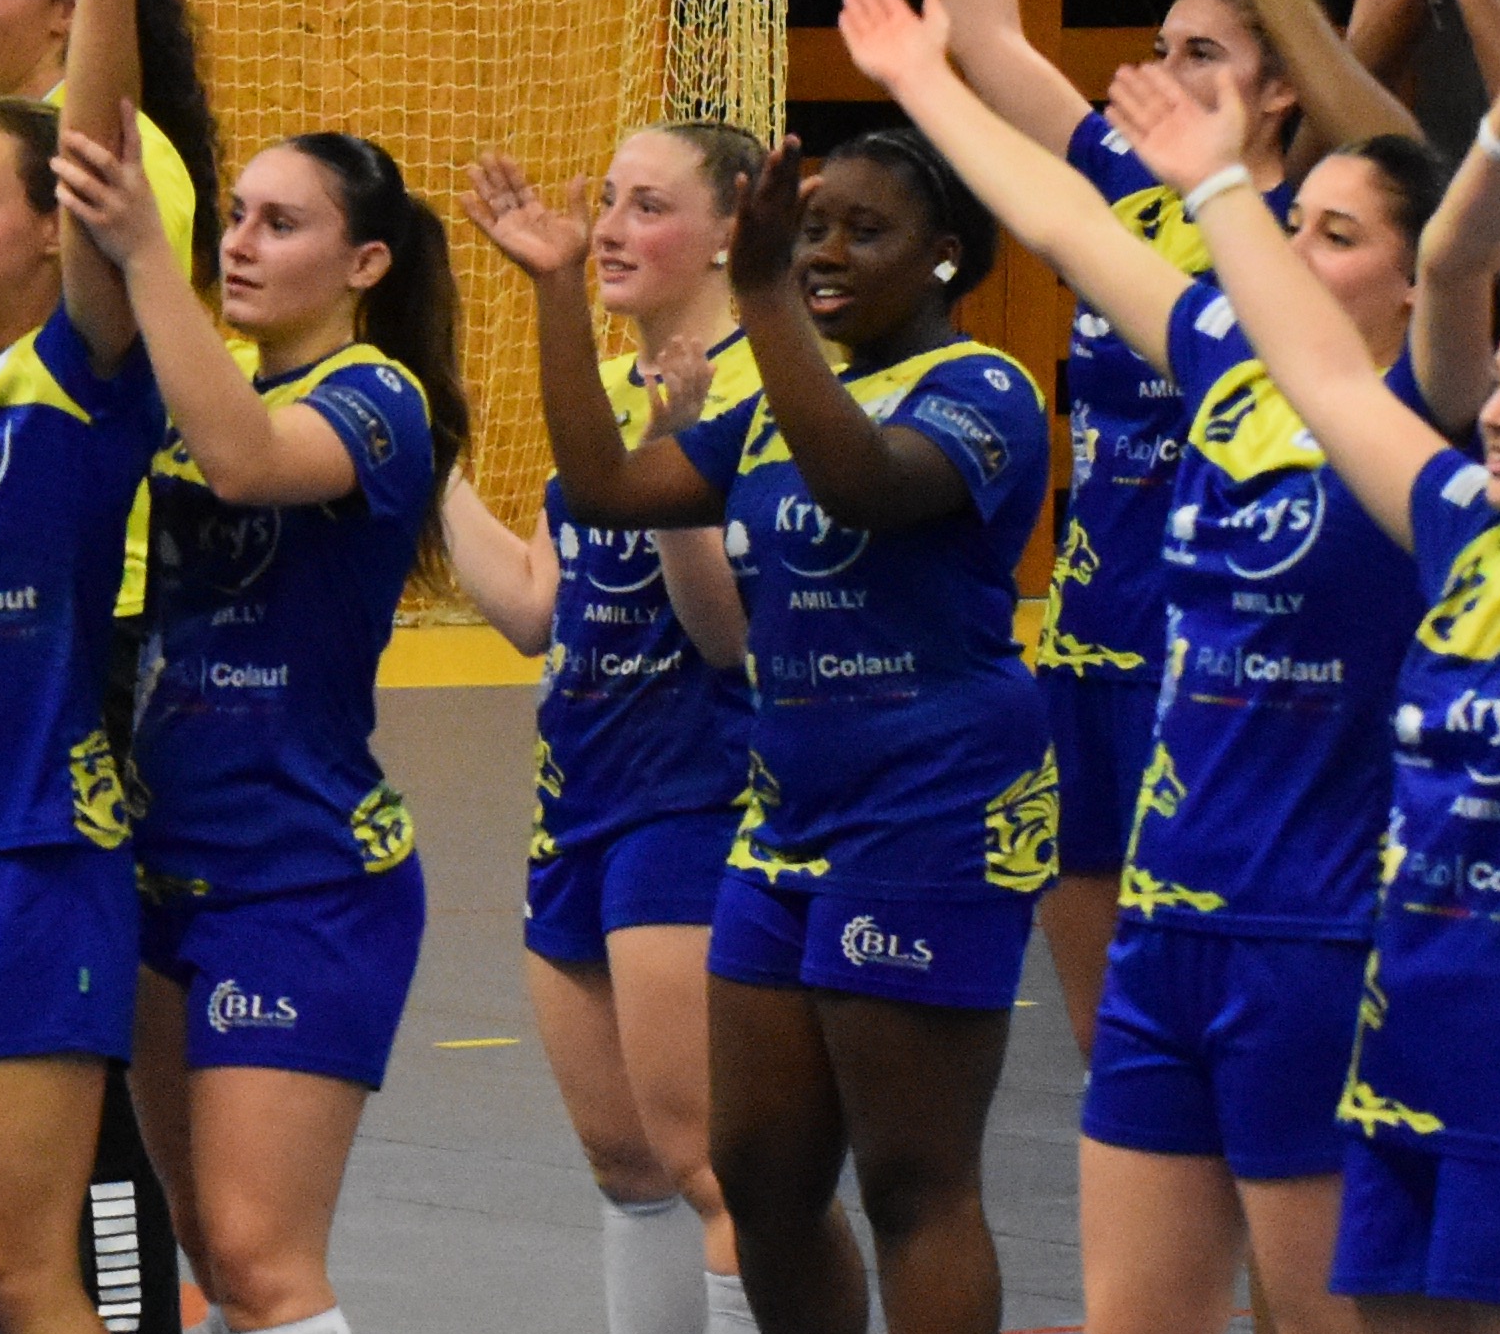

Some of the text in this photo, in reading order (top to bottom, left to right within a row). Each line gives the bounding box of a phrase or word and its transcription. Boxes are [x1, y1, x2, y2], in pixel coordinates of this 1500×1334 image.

[789, 590, 867, 610] AMILLY
[583, 603, 660, 625] AMILLY
[817, 651, 916, 679] Colaut
[1244, 653, 1344, 684] Colaut
[862, 929, 934, 963] BLS
[225, 994, 299, 1021] BLS
